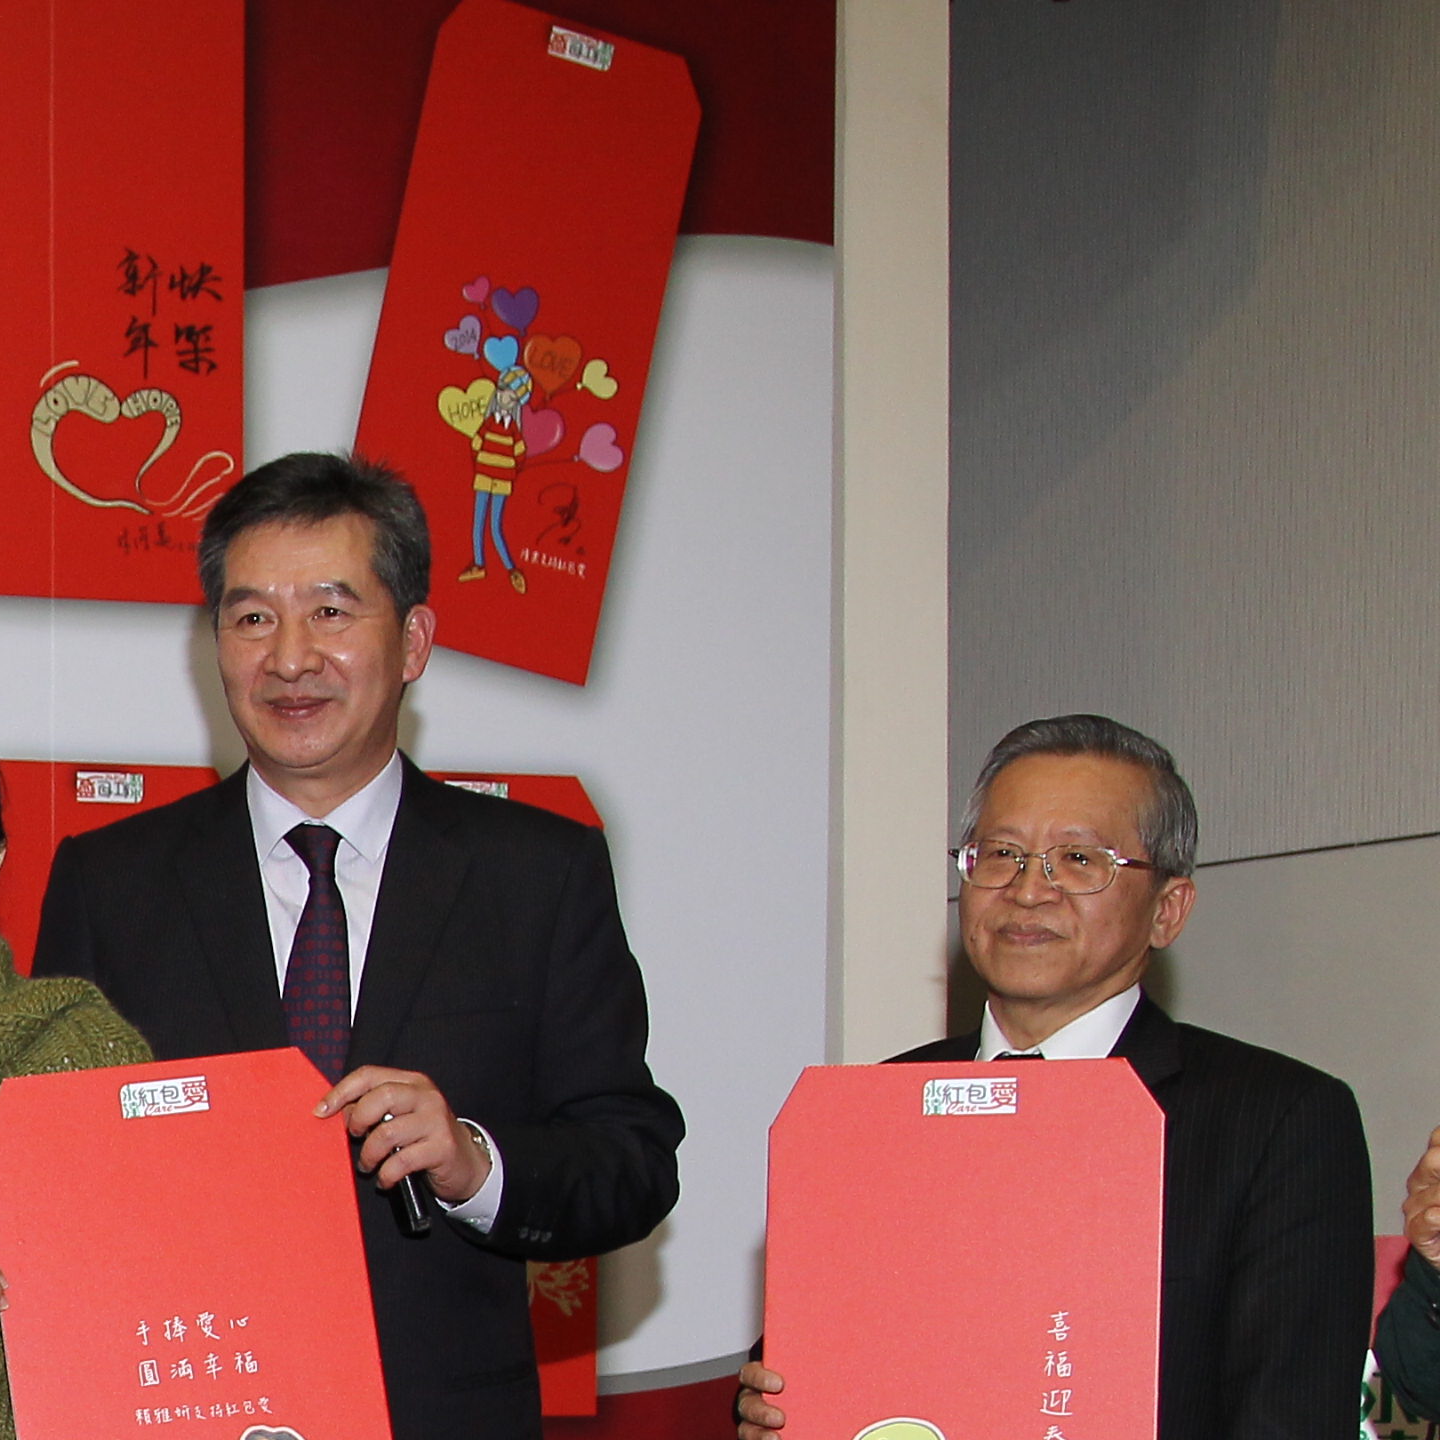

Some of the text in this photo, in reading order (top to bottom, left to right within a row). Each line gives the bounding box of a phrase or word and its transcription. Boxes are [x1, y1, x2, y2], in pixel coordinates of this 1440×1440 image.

[135, 1311, 250, 1346] 手捧愛心
[138, 1350, 260, 1388] 圓滿幸福
